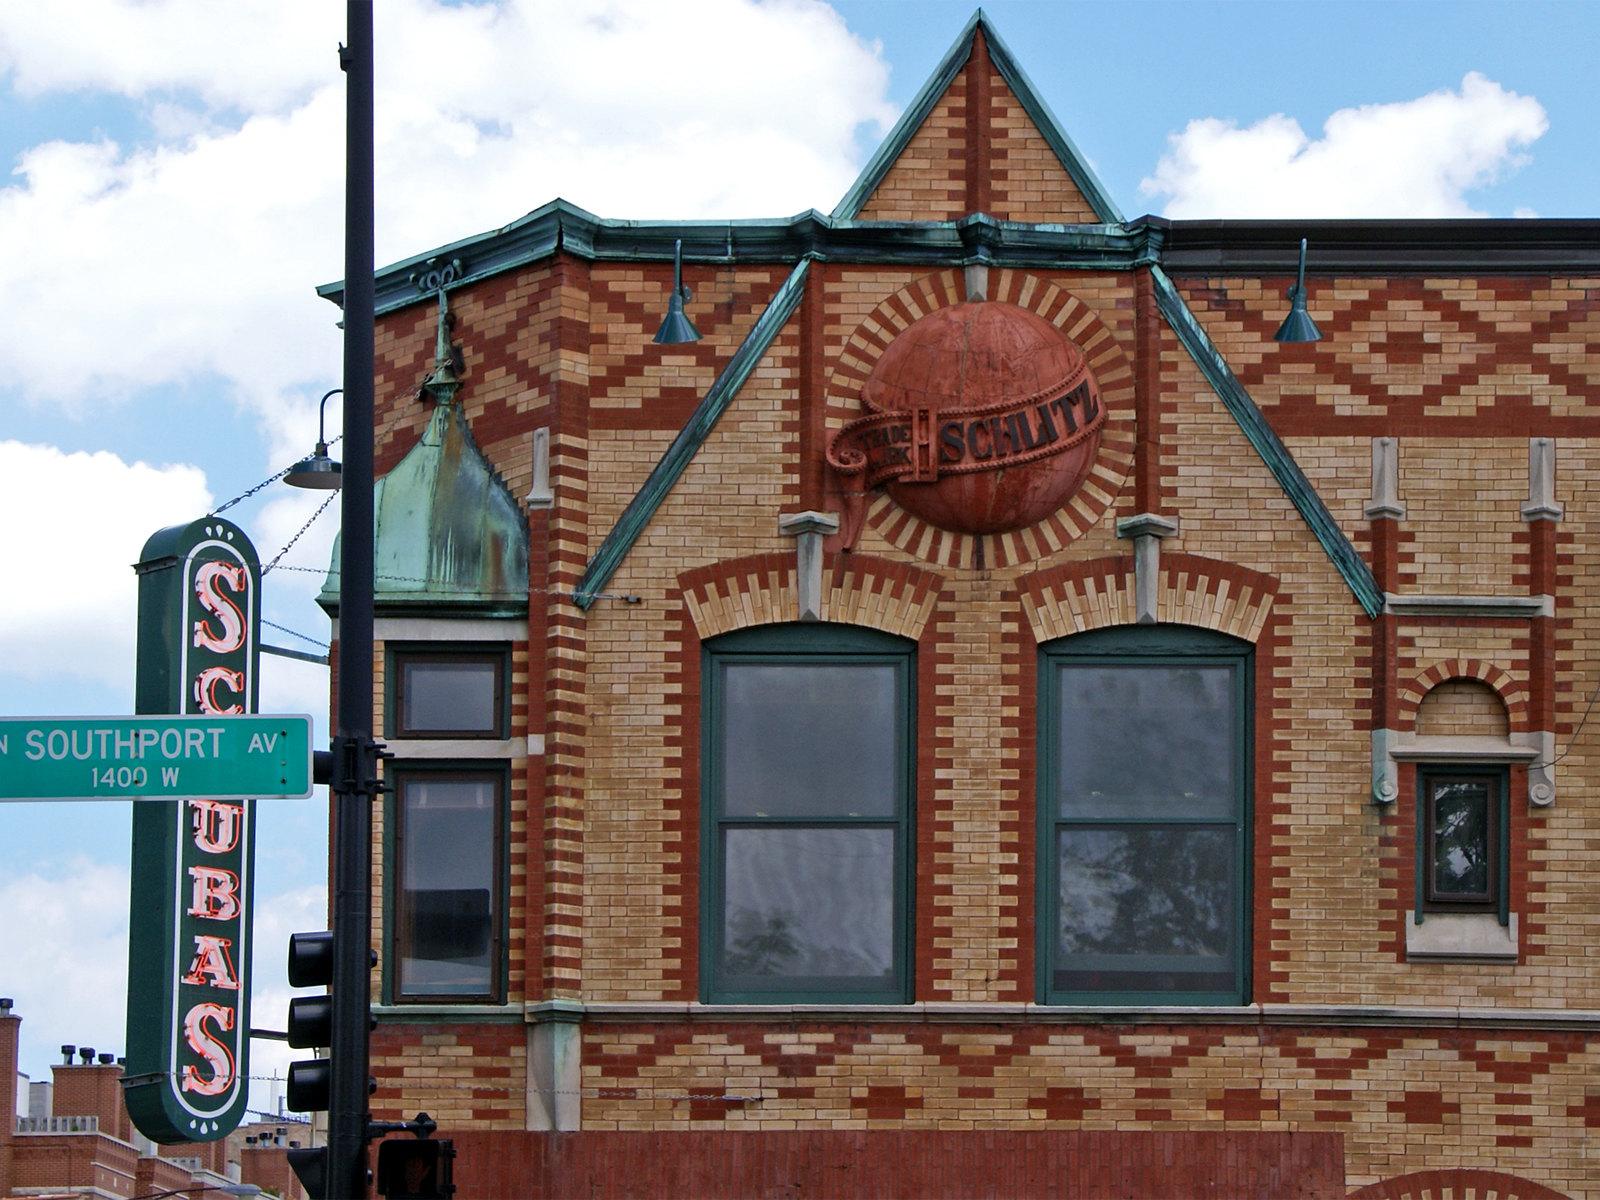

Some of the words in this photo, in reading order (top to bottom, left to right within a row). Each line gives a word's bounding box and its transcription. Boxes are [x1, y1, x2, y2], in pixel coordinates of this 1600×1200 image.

[940, 378, 1099, 463] SCHLITZ
[25, 728, 225, 760] SOUTHPORT
[248, 733, 278, 753] AV
[92, 767, 148, 788] 1400
[161, 767, 180, 787] W
[181, 561, 246, 1097] SCUBAS
